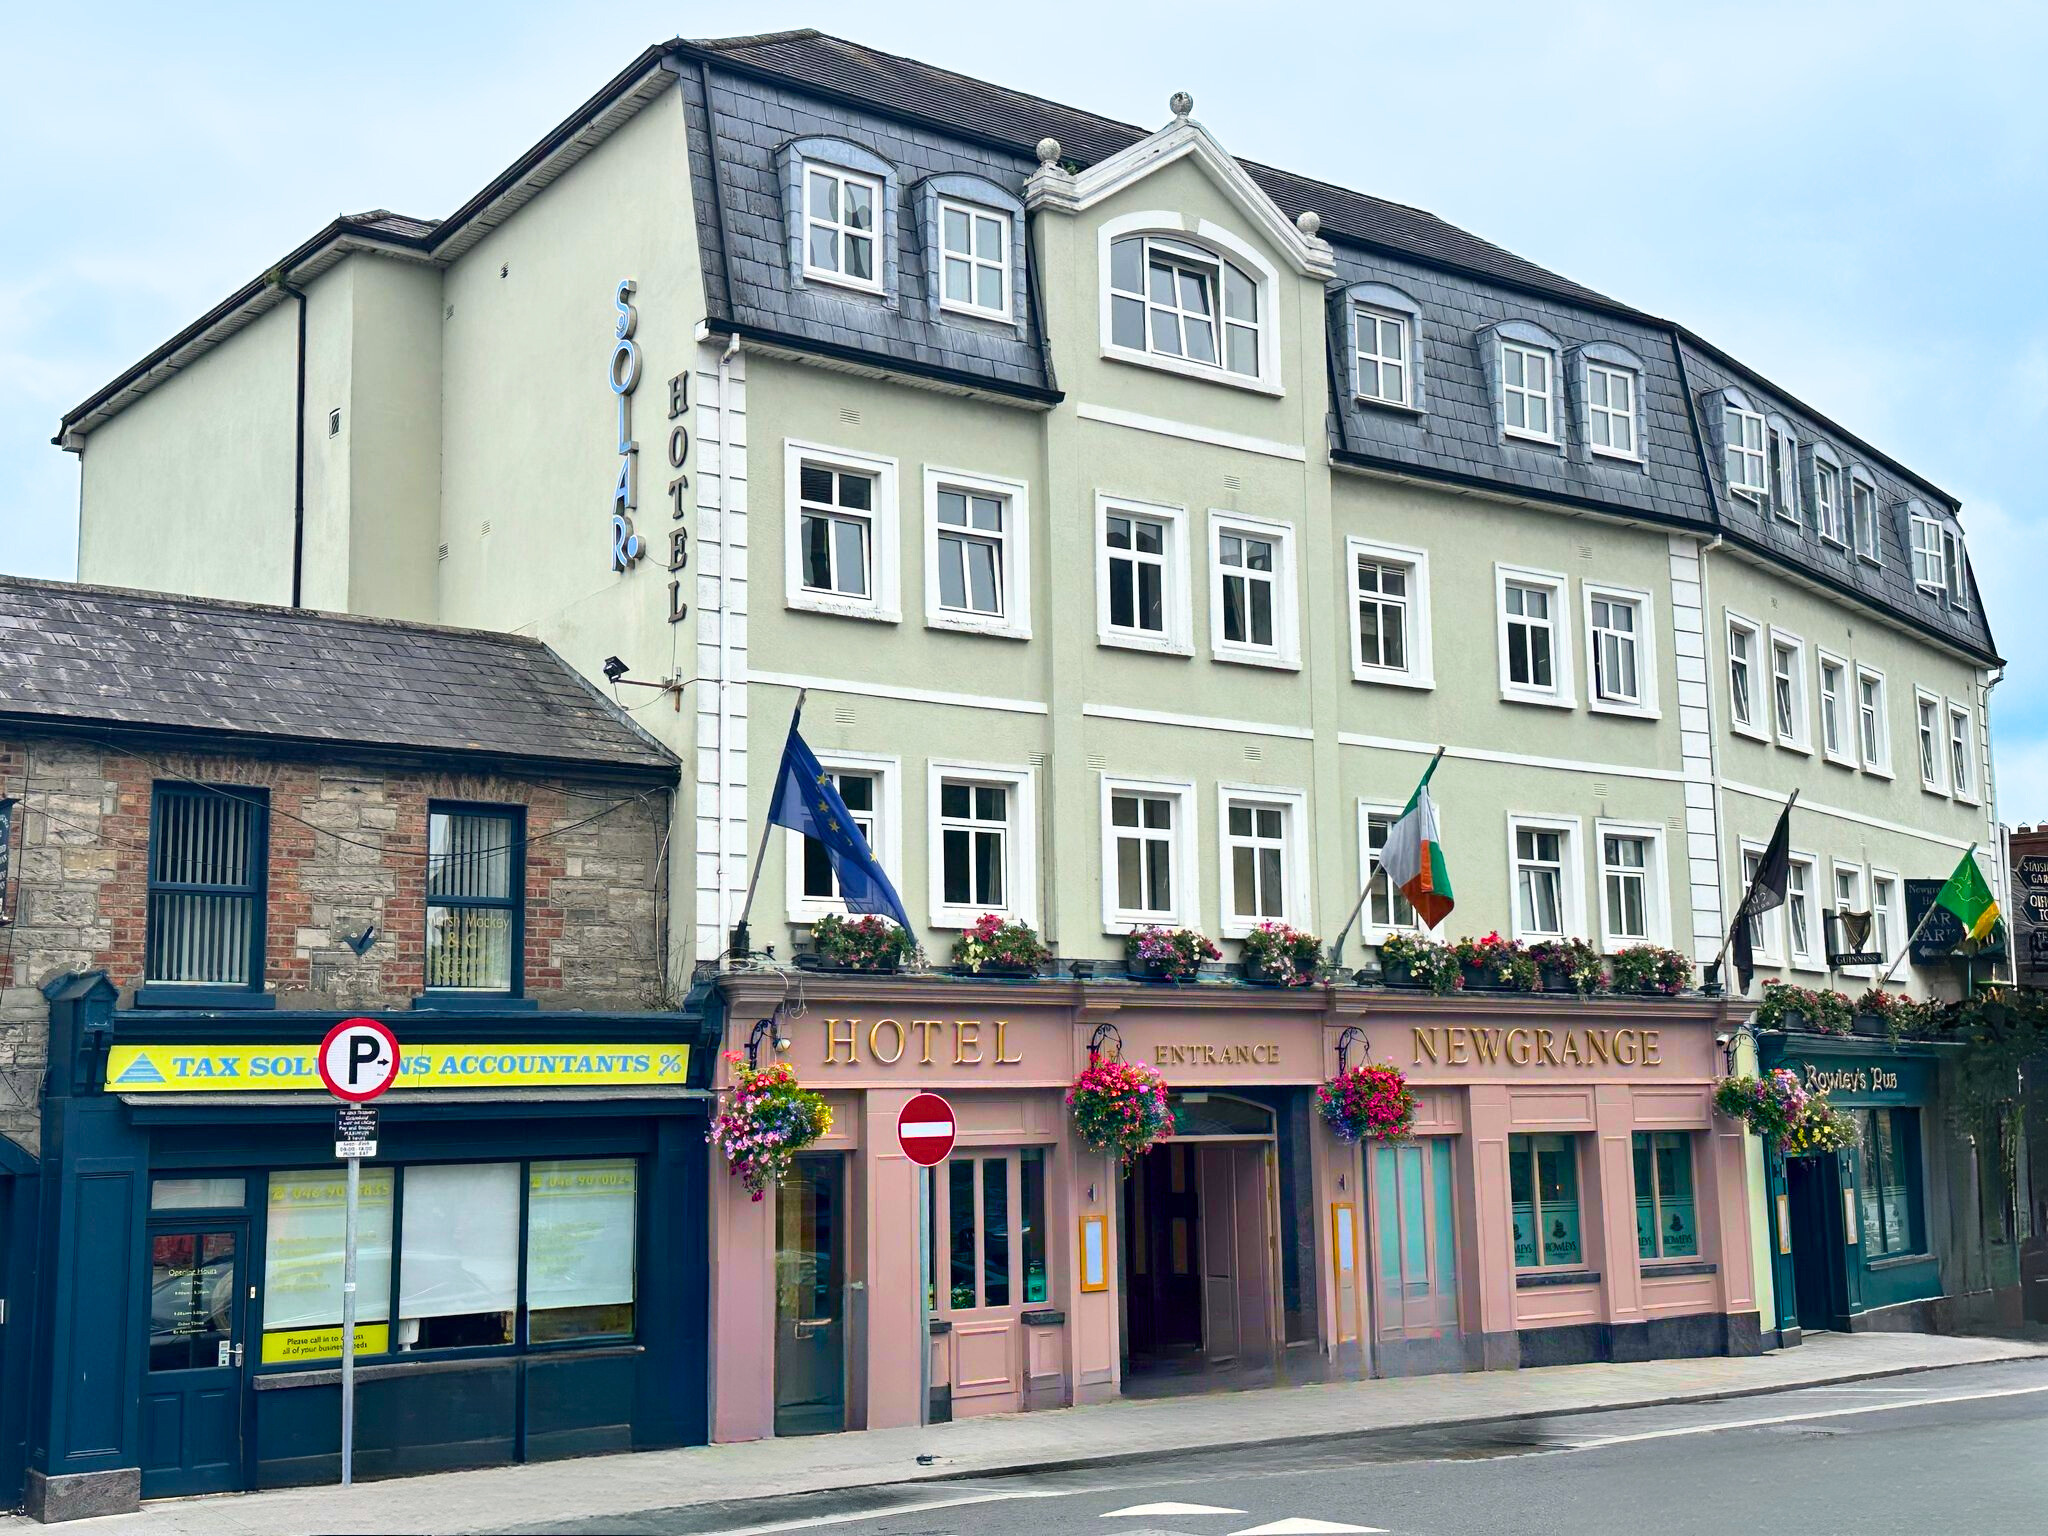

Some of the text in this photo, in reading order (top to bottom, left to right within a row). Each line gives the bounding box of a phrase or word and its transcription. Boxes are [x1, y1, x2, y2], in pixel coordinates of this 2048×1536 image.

[609, 278, 645, 572] SOLAR
[667, 369, 689, 624] HOTEL
[1835, 954, 1878, 965] GUINNESS
[824, 1018, 1023, 1066] HOTEL
[1155, 1043, 1281, 1066] ENTRANCE
[1413, 1026, 1663, 1067] NEWGRANGE
[172, 1056, 241, 1077] TAX
[249, 1055, 431, 1077] SOLNS
[438, 1055, 650, 1075] ACCOUNTANTS
[348, 1035, 381, 1085] P
[1804, 1063, 1867, 1094] Rowley's
[1545, 1240, 1577, 1252] ROWLEYS
[282, 1346, 290, 1354] all
[300, 1346, 316, 1355] your
[287, 1338, 308, 1346] Please
